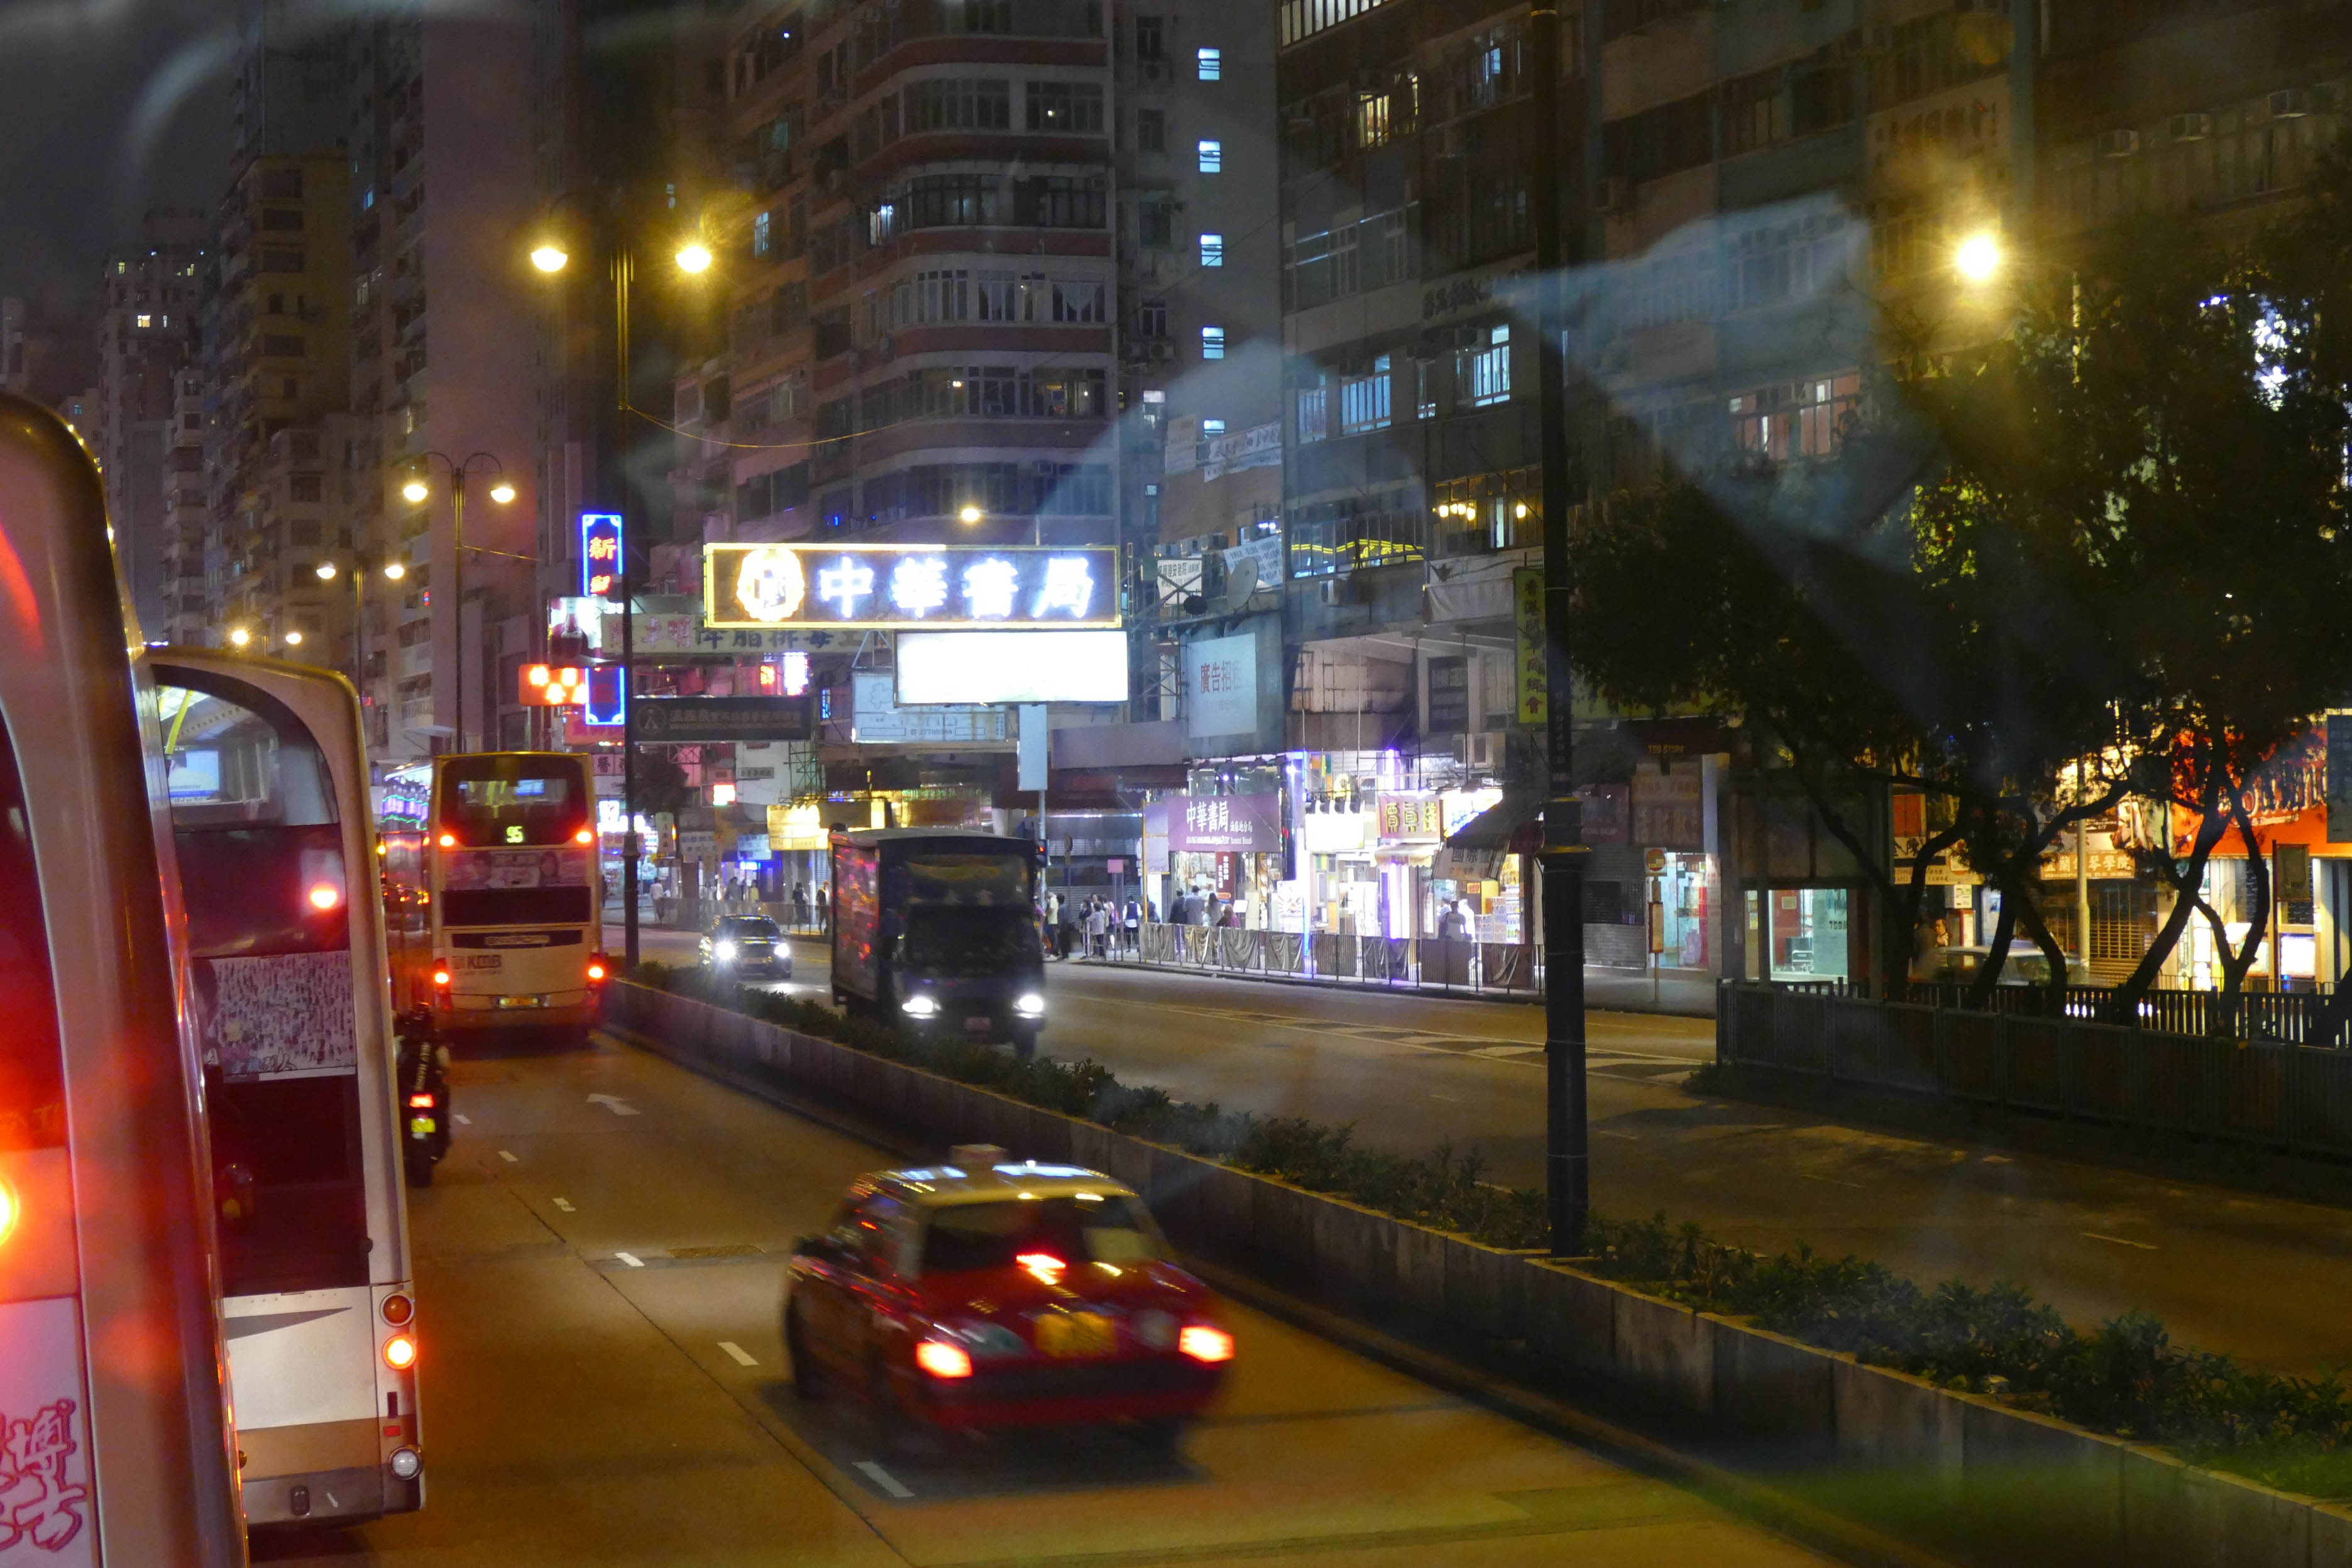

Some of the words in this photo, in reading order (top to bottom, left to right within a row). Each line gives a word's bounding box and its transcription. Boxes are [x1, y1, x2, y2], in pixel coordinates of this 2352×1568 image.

[820, 557, 1094, 619] 中華書局
[1187, 800, 1229, 833] 中華書局
